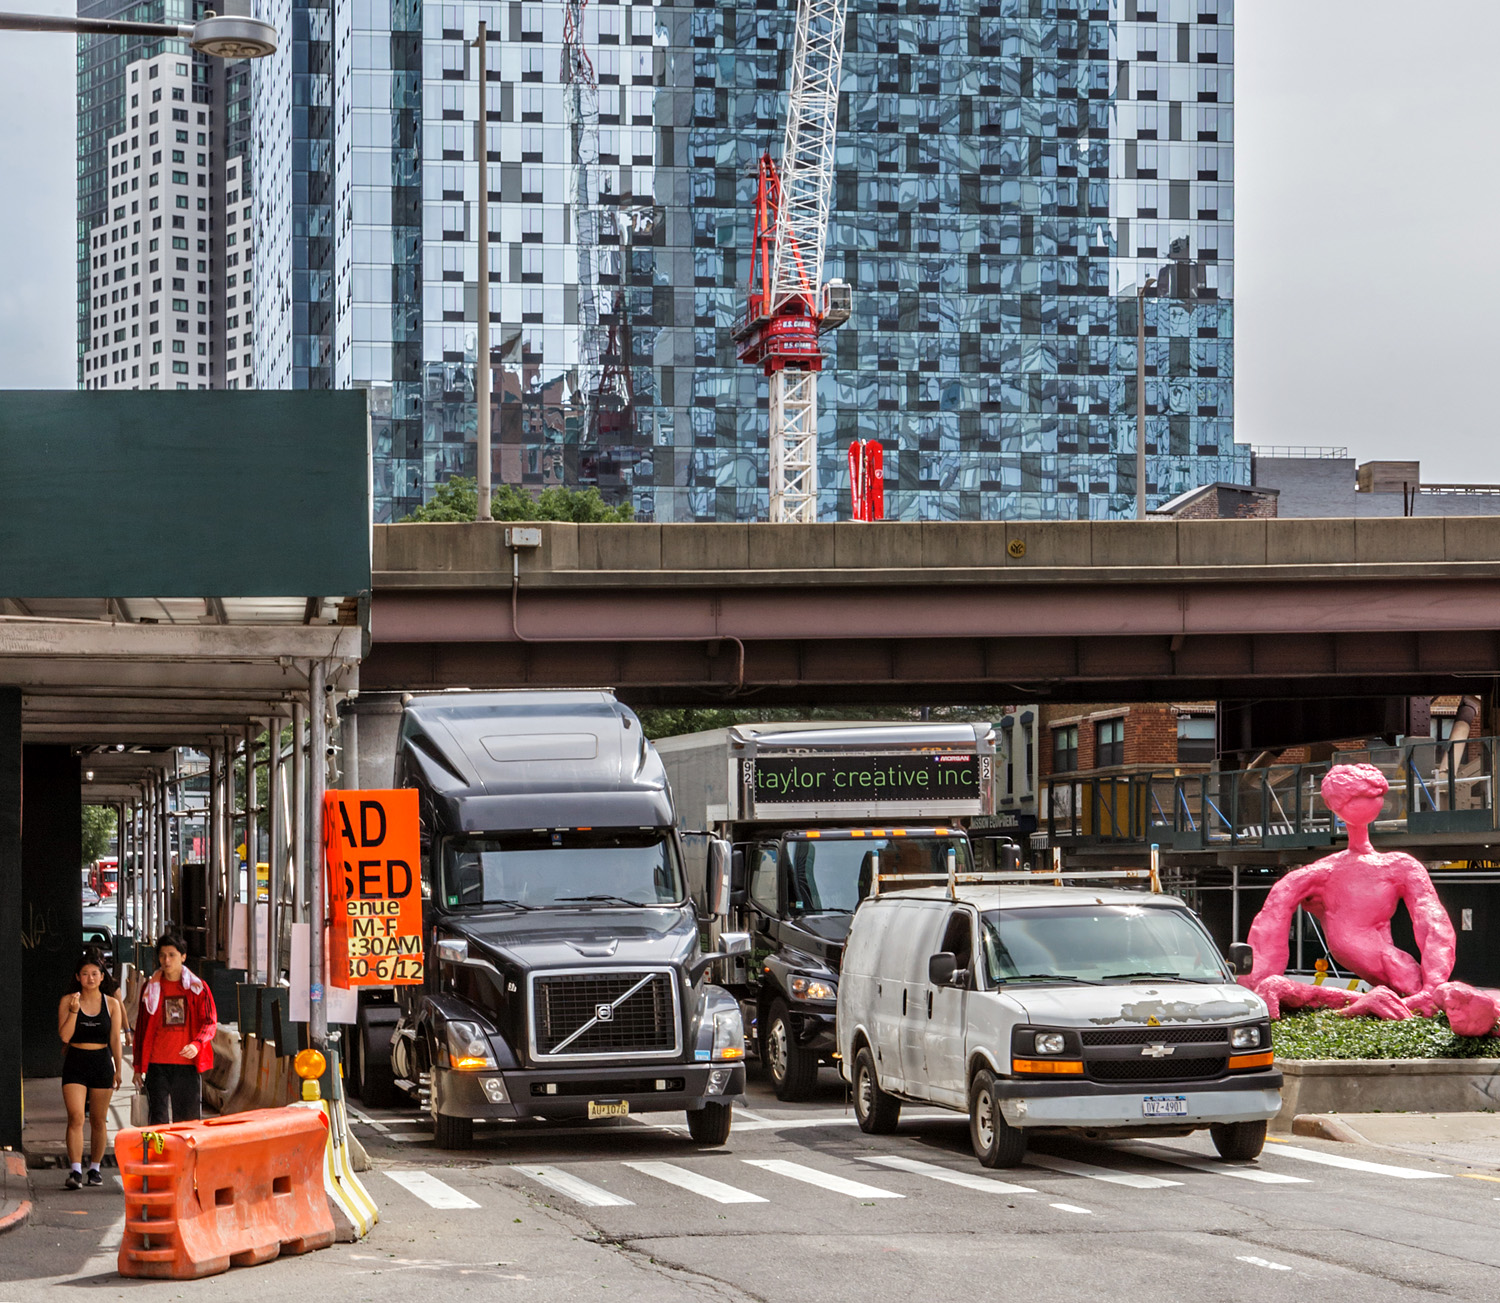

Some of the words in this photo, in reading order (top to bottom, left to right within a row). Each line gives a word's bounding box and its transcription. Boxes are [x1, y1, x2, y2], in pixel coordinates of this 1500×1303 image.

[757, 766, 826, 794] taylor
[834, 764, 929, 788] creative
[937, 764, 979, 786] inc.
[347, 900, 400, 916] enue
[352, 918, 397, 937] M-F
